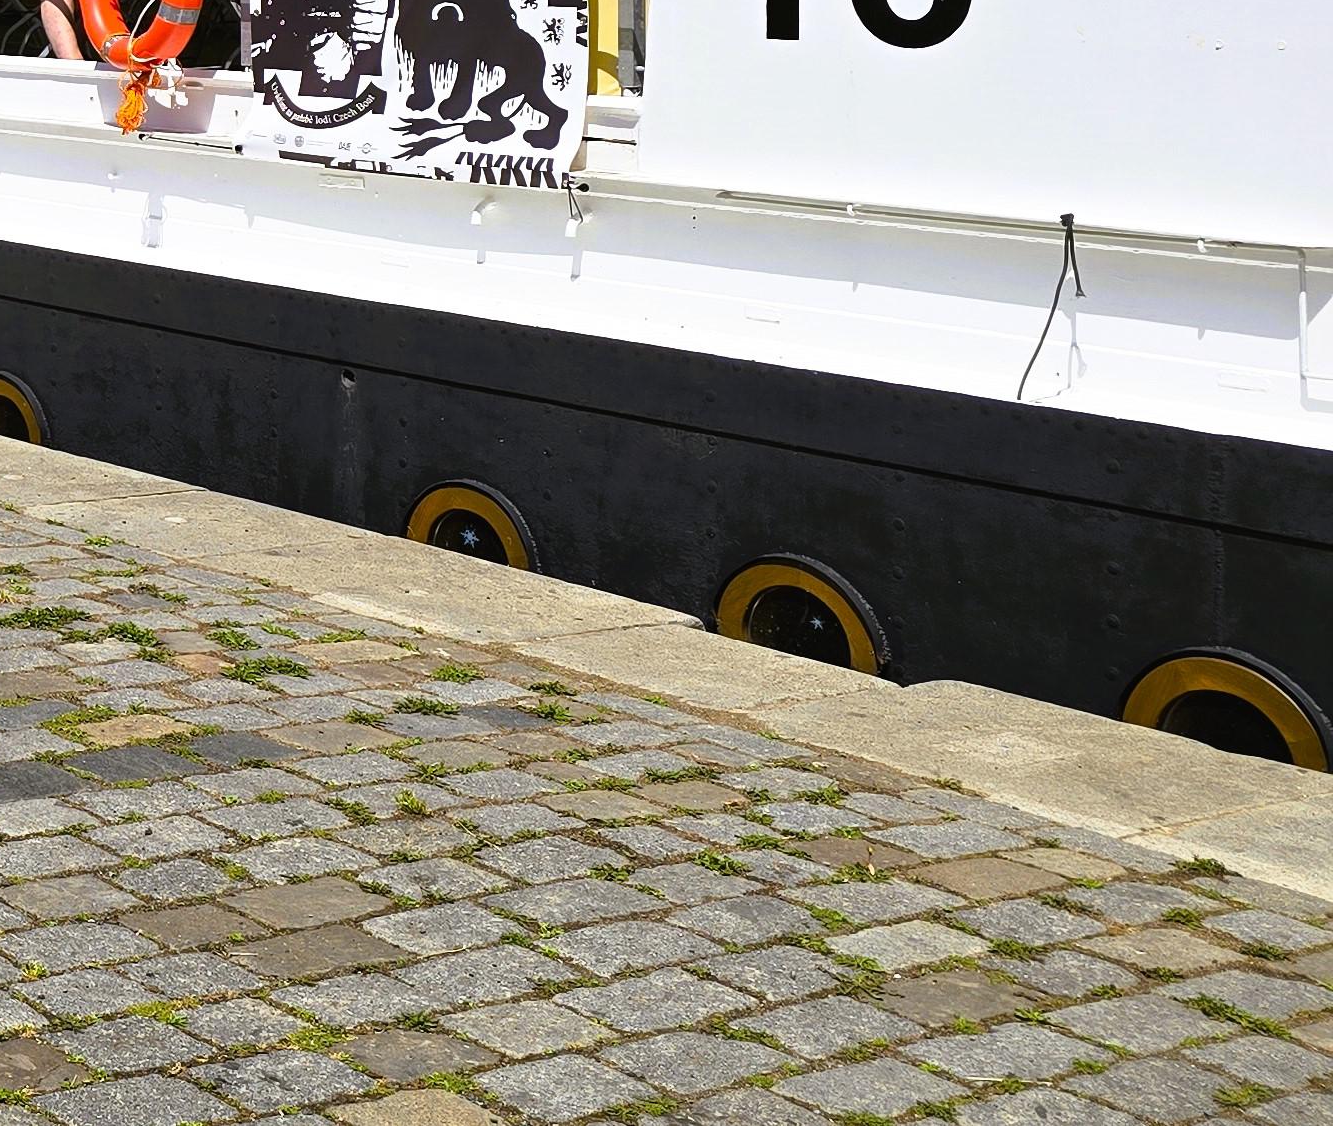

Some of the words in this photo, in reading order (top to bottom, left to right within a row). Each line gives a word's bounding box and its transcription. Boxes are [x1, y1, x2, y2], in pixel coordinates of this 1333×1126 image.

[315, 114, 332, 124] lodi
[332, 108, 357, 123] Czech
[355, 92, 375, 111] Boat
